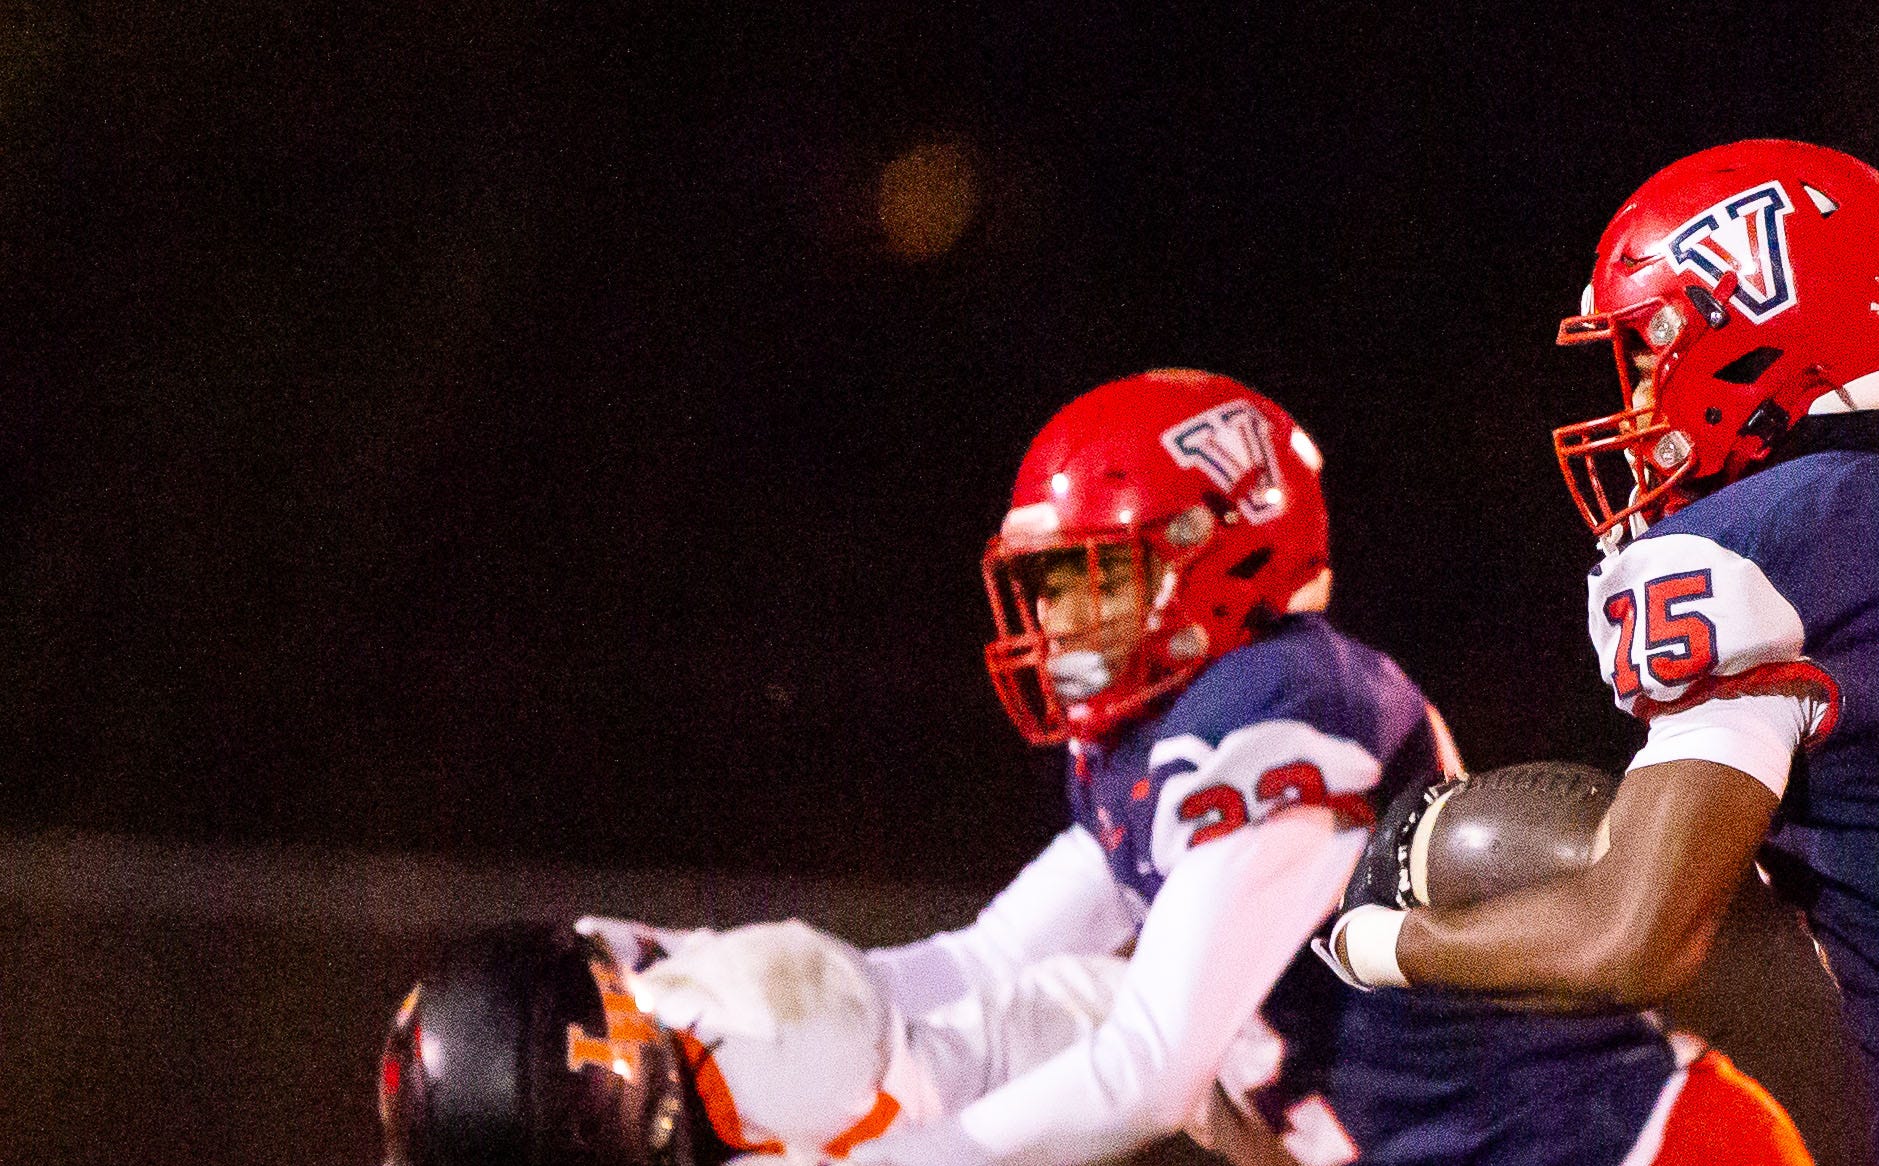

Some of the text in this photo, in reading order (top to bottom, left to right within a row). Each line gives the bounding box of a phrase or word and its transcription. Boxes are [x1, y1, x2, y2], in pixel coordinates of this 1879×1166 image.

[1667, 180, 1795, 323] V
[1162, 401, 1283, 522] V
[1604, 571, 1714, 698] 15
